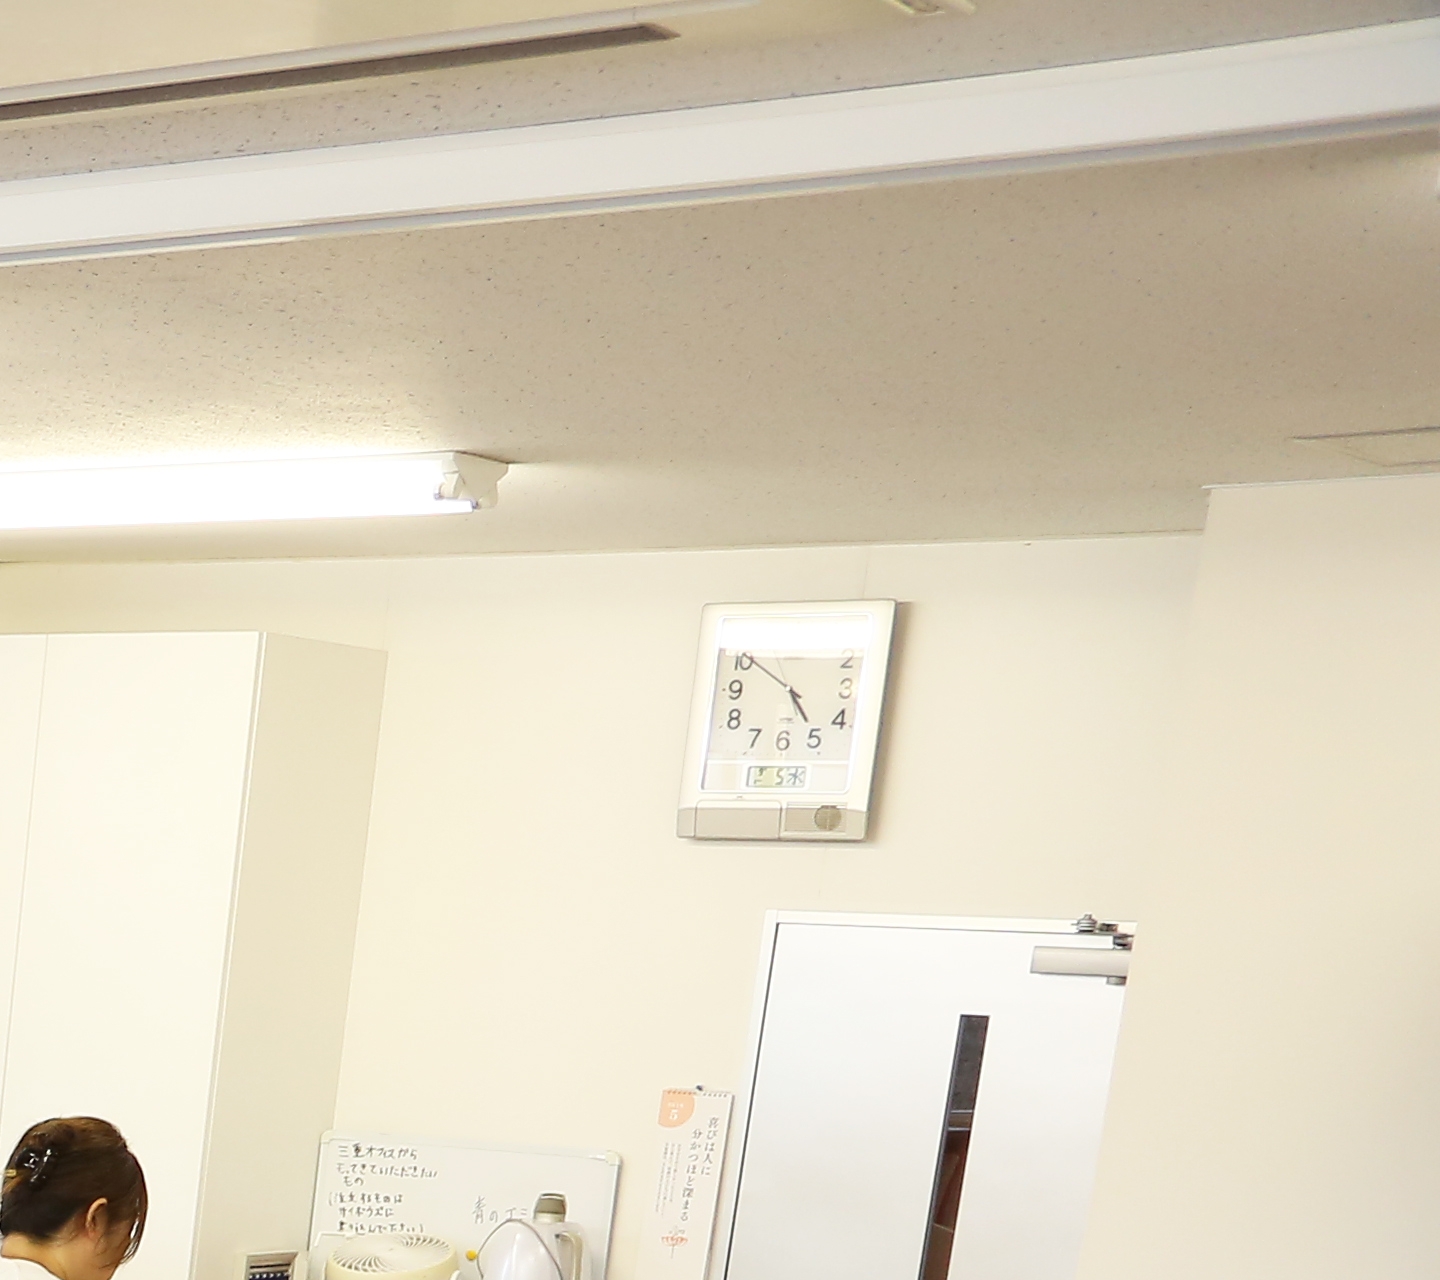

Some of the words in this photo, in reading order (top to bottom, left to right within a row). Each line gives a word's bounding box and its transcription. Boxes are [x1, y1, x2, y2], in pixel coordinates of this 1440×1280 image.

[733, 652, 754, 671] 10
[840, 648, 855, 669] 2
[728, 679, 743, 700] 9
[838, 678, 853, 700] 3
[726, 708, 741, 731] 8
[830, 708, 847, 731] 4
[747, 728, 762, 749] 7
[775, 729, 790, 751] 6
[806, 728, 822, 749] 5
[786, 768, 805, 785] 水
[668, 1109, 679, 1121] 5
[699, 1116, 720, 1177] 喜びは人に
[680, 1128, 704, 1222] 分かつほど深まる
